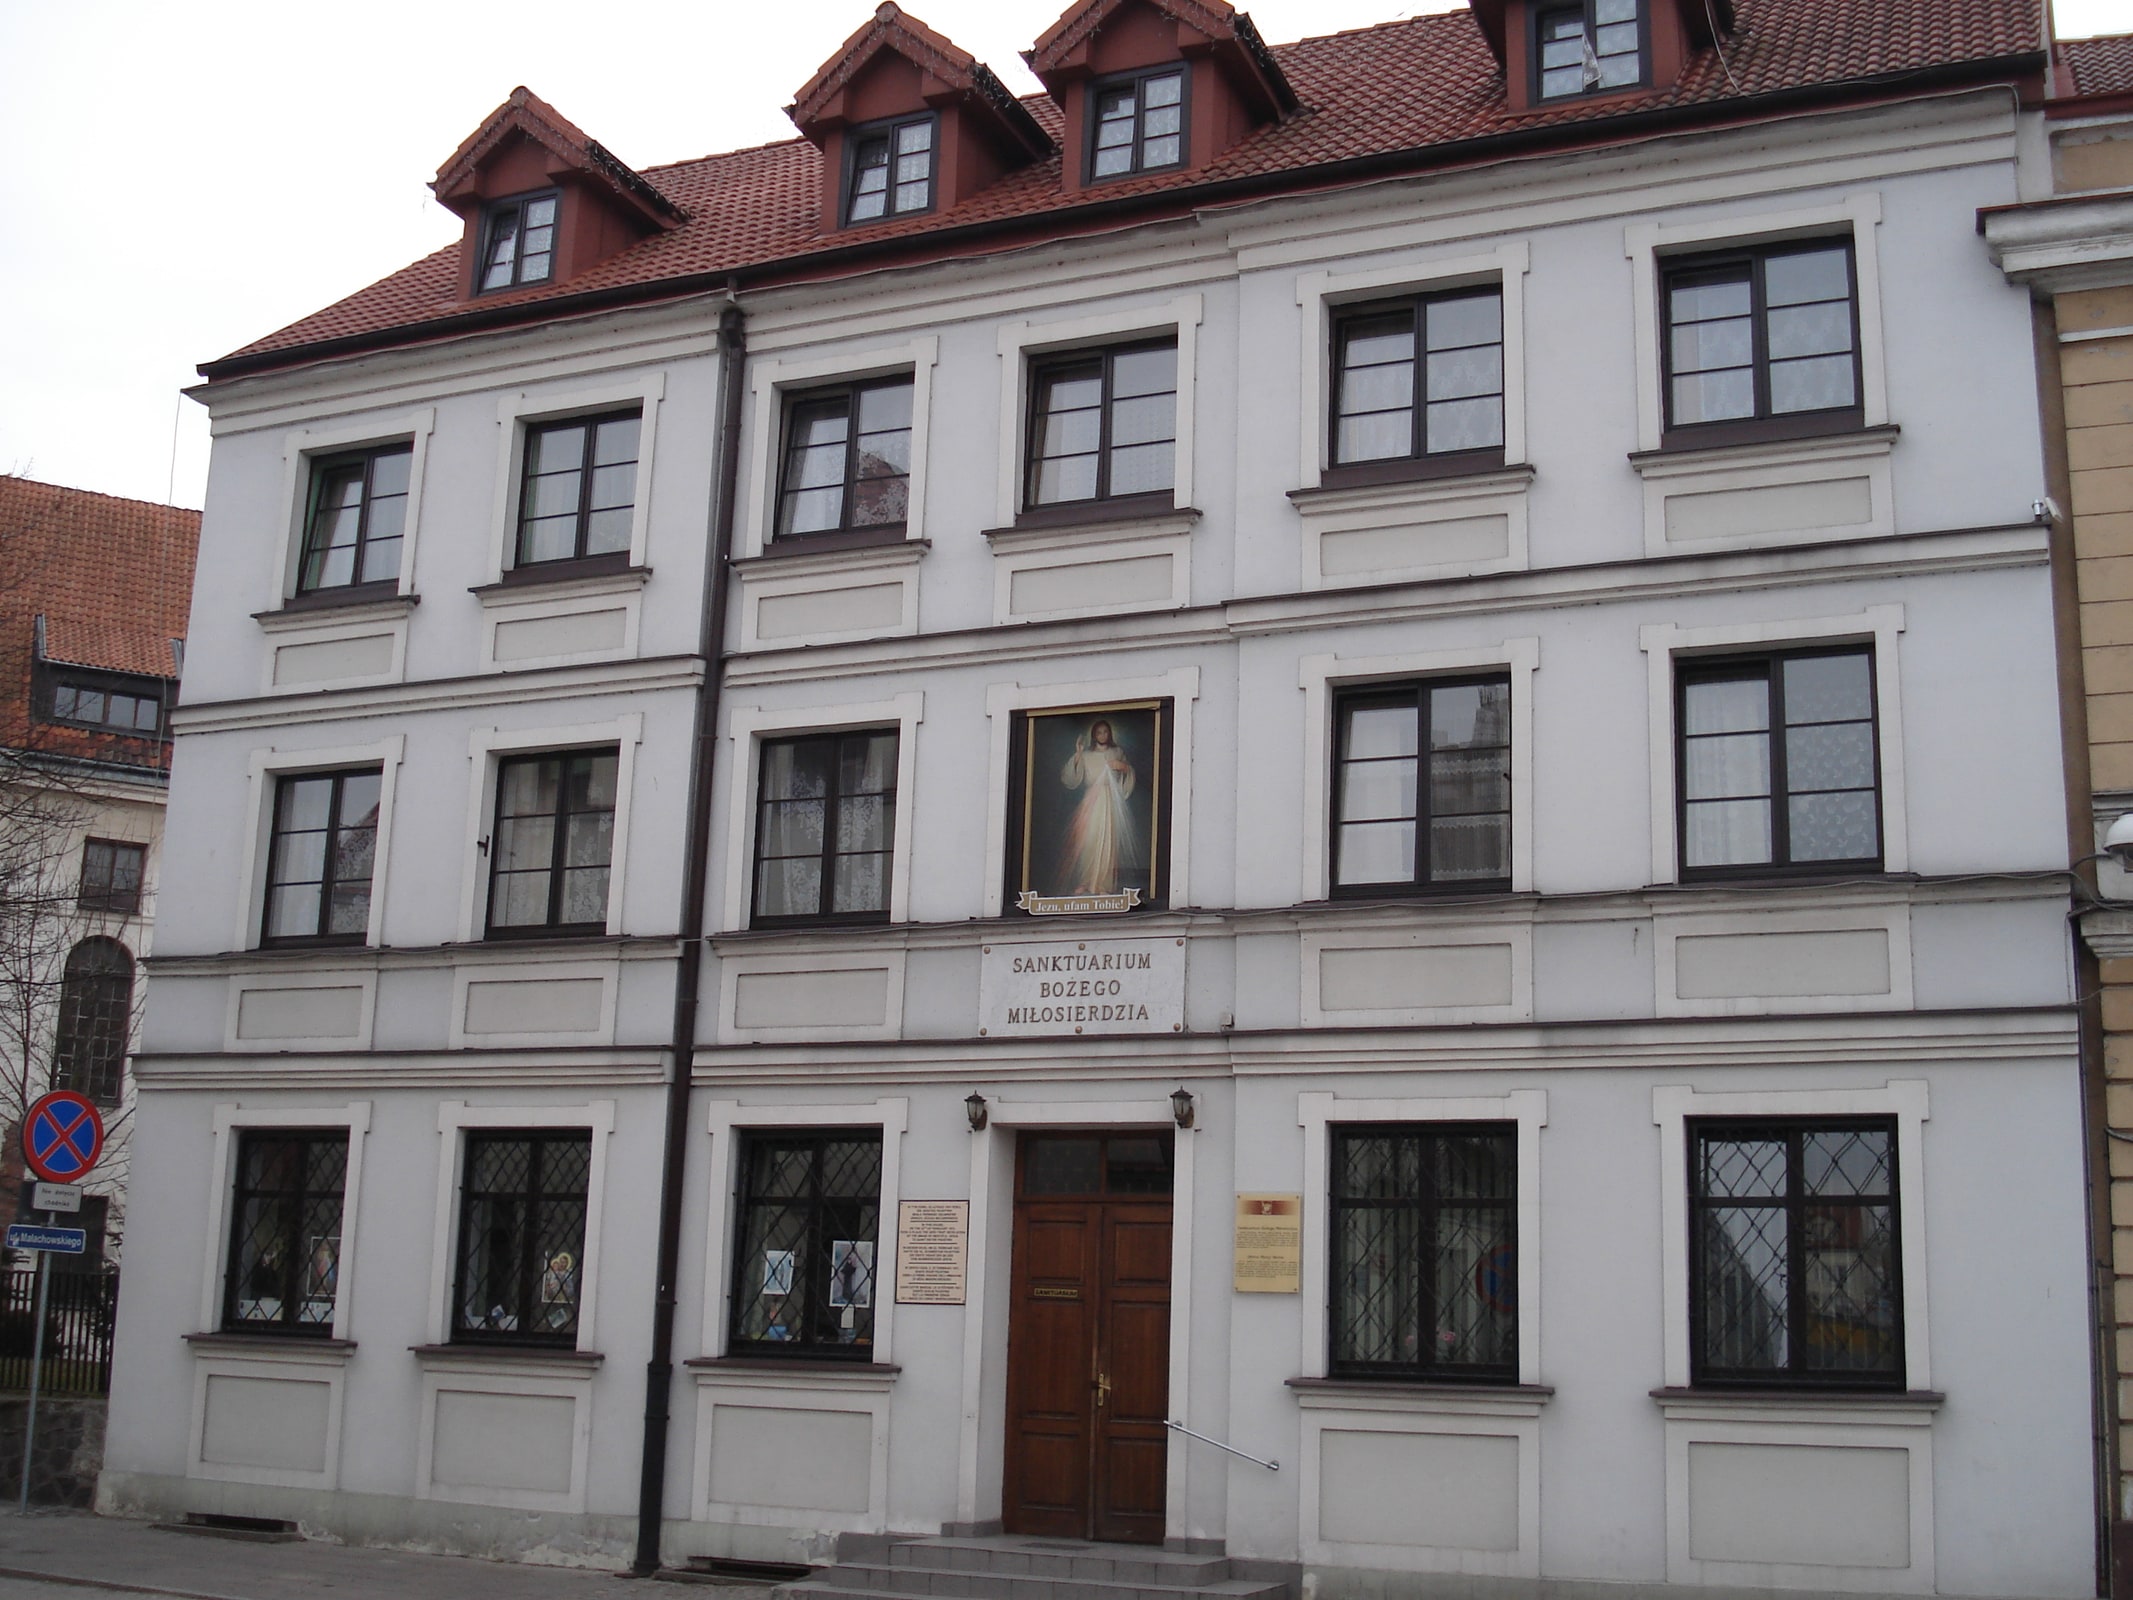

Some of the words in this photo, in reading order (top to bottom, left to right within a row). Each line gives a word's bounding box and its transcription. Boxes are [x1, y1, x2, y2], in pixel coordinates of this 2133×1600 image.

[1035, 901, 1061, 912] Jezu,
[1064, 900, 1089, 911] ufam
[1094, 899, 1124, 910] Tobie!
[1012, 953, 1151, 973] SANKTUARIUM
[1040, 976, 1121, 998] BOŻEGO
[1007, 1003, 1149, 1024] MIŁOSIERDZIA
